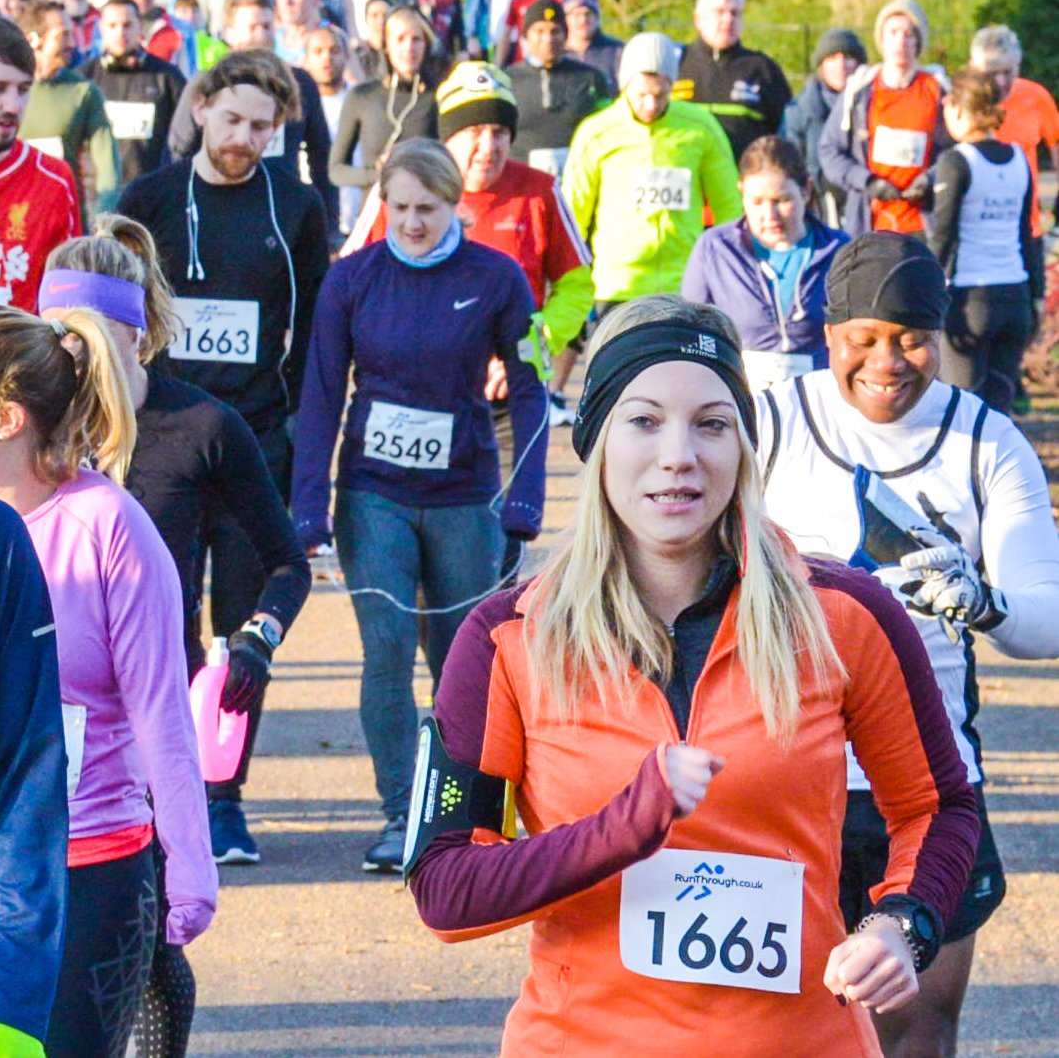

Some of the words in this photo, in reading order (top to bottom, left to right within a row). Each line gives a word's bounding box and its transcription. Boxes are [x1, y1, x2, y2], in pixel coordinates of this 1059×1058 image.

[636, 186, 684, 206] 2204
[184, 328, 250, 356] 1663
[373, 430, 442, 462] 2549
[674, 873, 764, 890] RunThrough.co.uk
[647, 910, 788, 979] 1665
